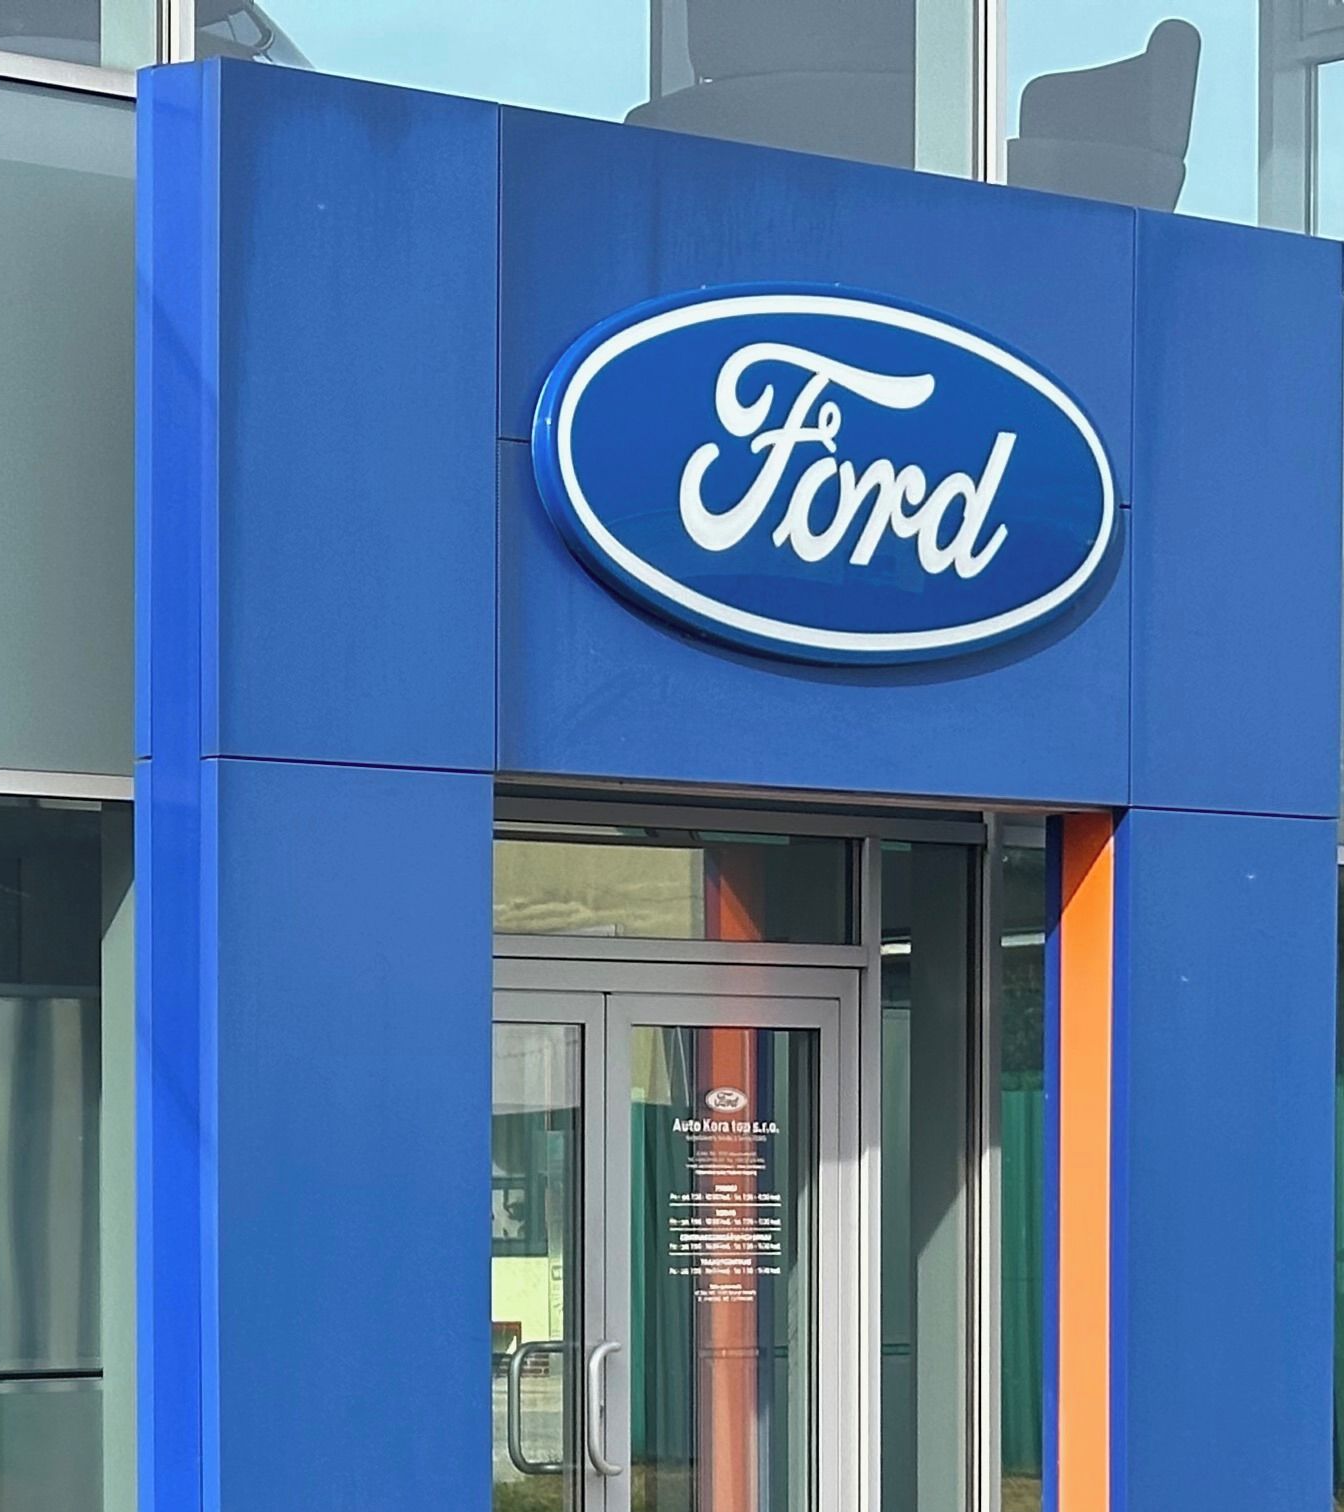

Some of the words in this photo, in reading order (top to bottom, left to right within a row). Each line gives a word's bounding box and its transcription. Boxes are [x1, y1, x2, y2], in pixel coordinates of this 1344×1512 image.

[679, 342, 1017, 580] Ford
[714, 1091, 740, 1108] Ford
[673, 1117, 702, 1132] Auto
[702, 1118, 730, 1133] Kora
[752, 1121, 780, 1134] s.r.o.
